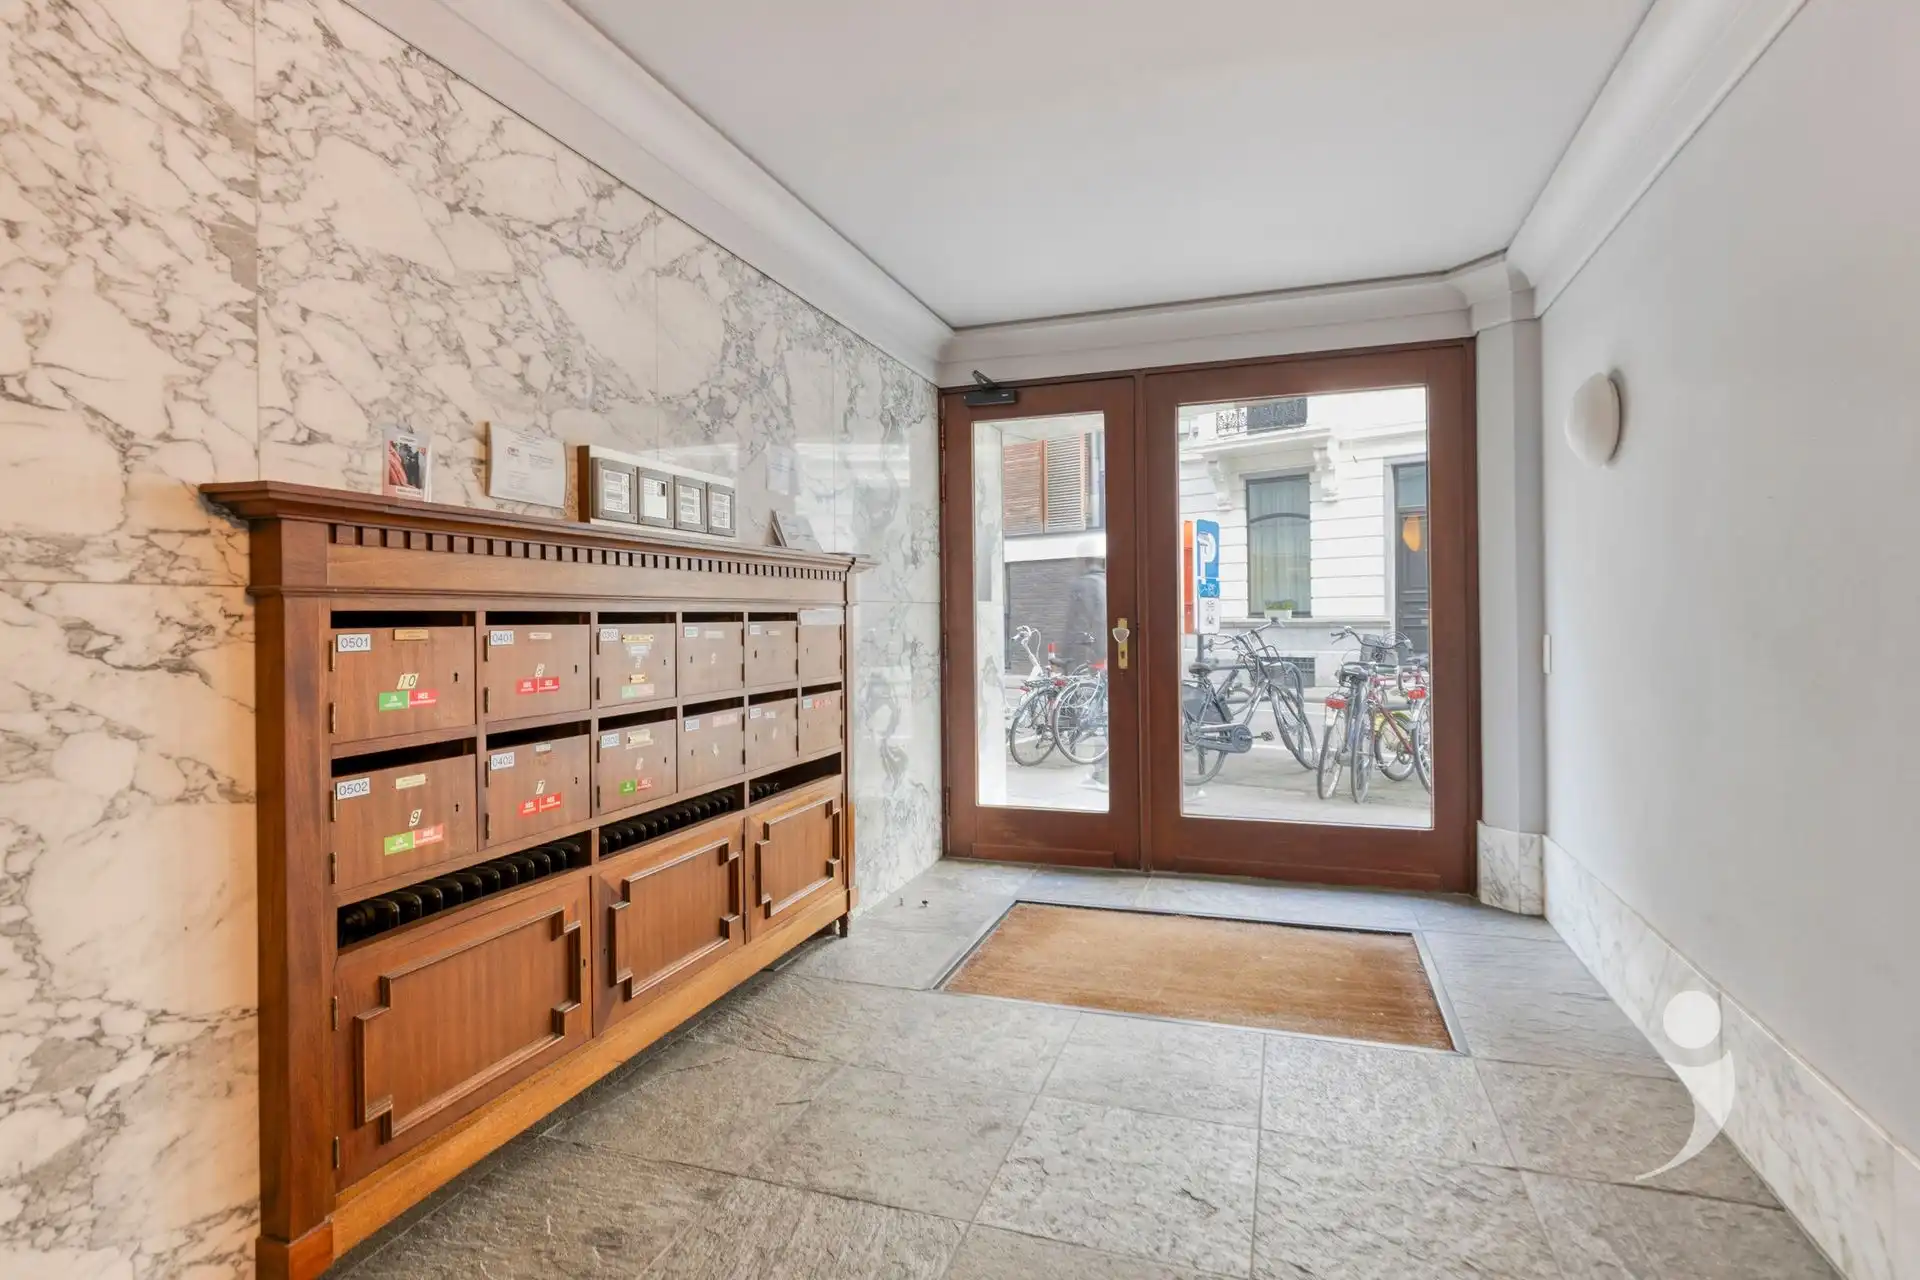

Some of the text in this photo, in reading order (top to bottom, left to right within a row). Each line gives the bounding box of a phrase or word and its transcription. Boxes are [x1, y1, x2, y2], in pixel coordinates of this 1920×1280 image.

[340, 637, 369, 648] 0501
[492, 632, 512, 643] 0401
[400, 674, 416, 689] 10
[492, 755, 513, 767] 0402
[339, 781, 368, 796] 0502
[410, 810, 419, 824] 9
